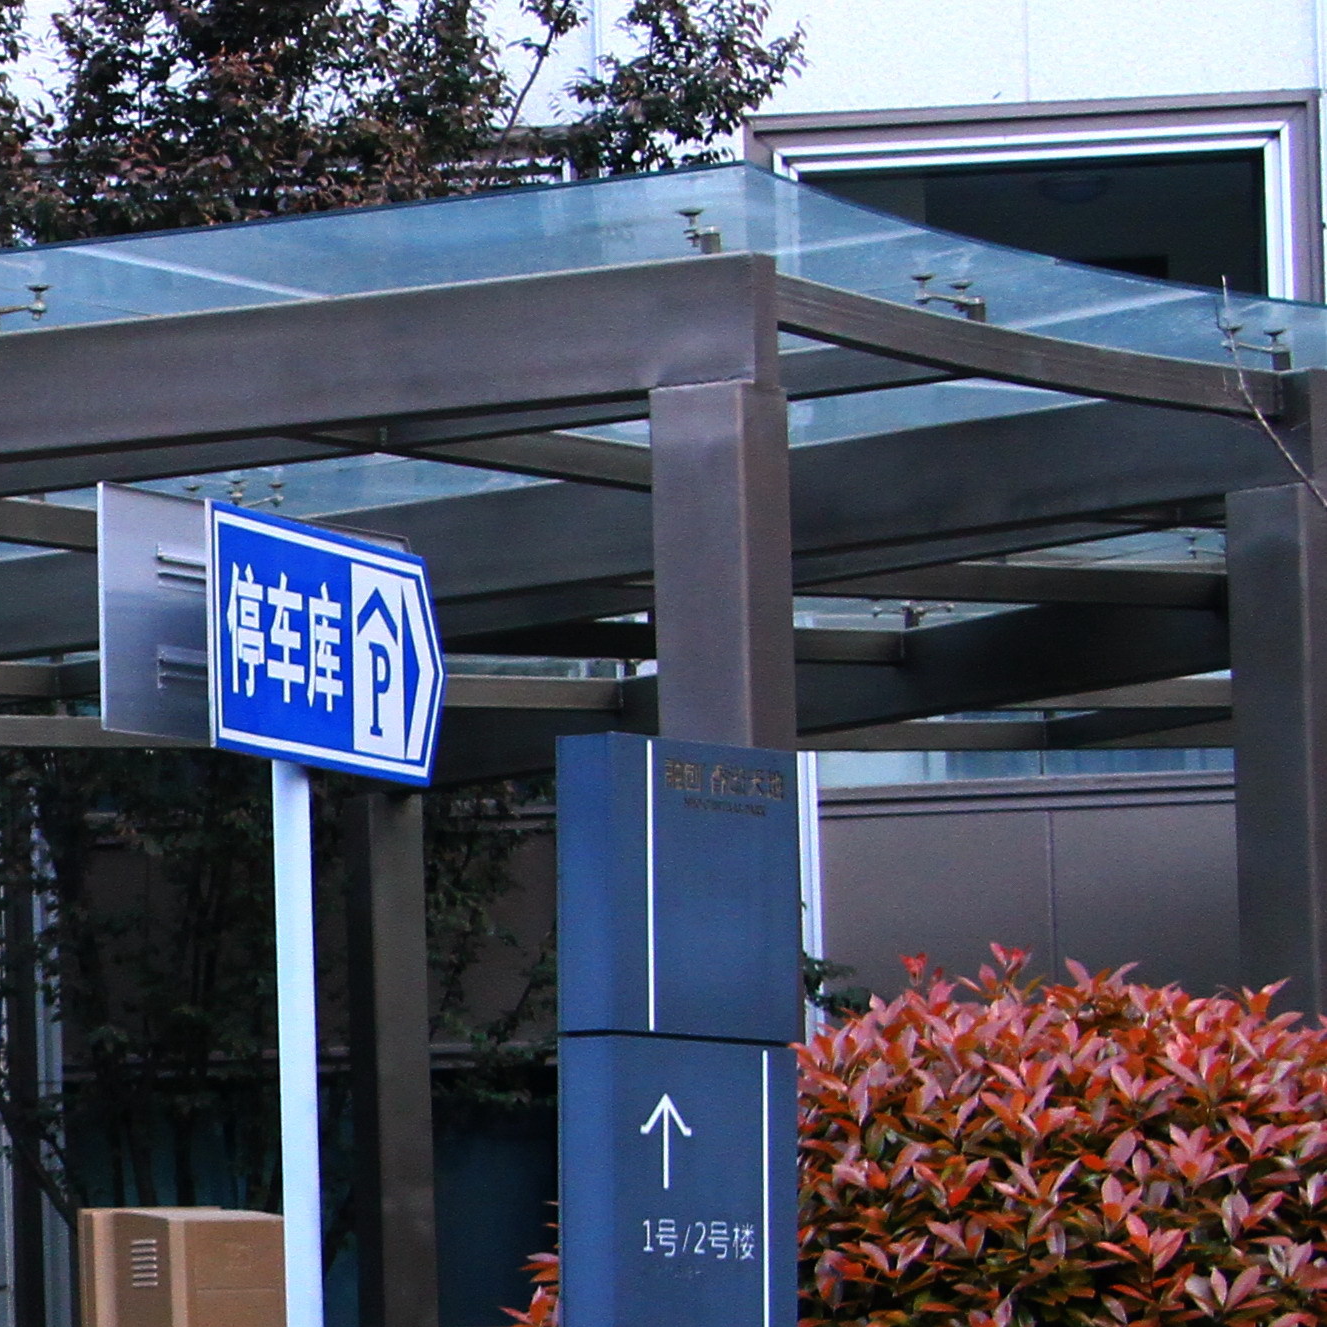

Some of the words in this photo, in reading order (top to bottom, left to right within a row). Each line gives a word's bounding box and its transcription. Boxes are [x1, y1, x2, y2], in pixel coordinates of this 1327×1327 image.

[226, 561, 344, 713] 停车库
[367, 640, 392, 738] P
[642, 1218, 755, 1260] 1号/2号楼
